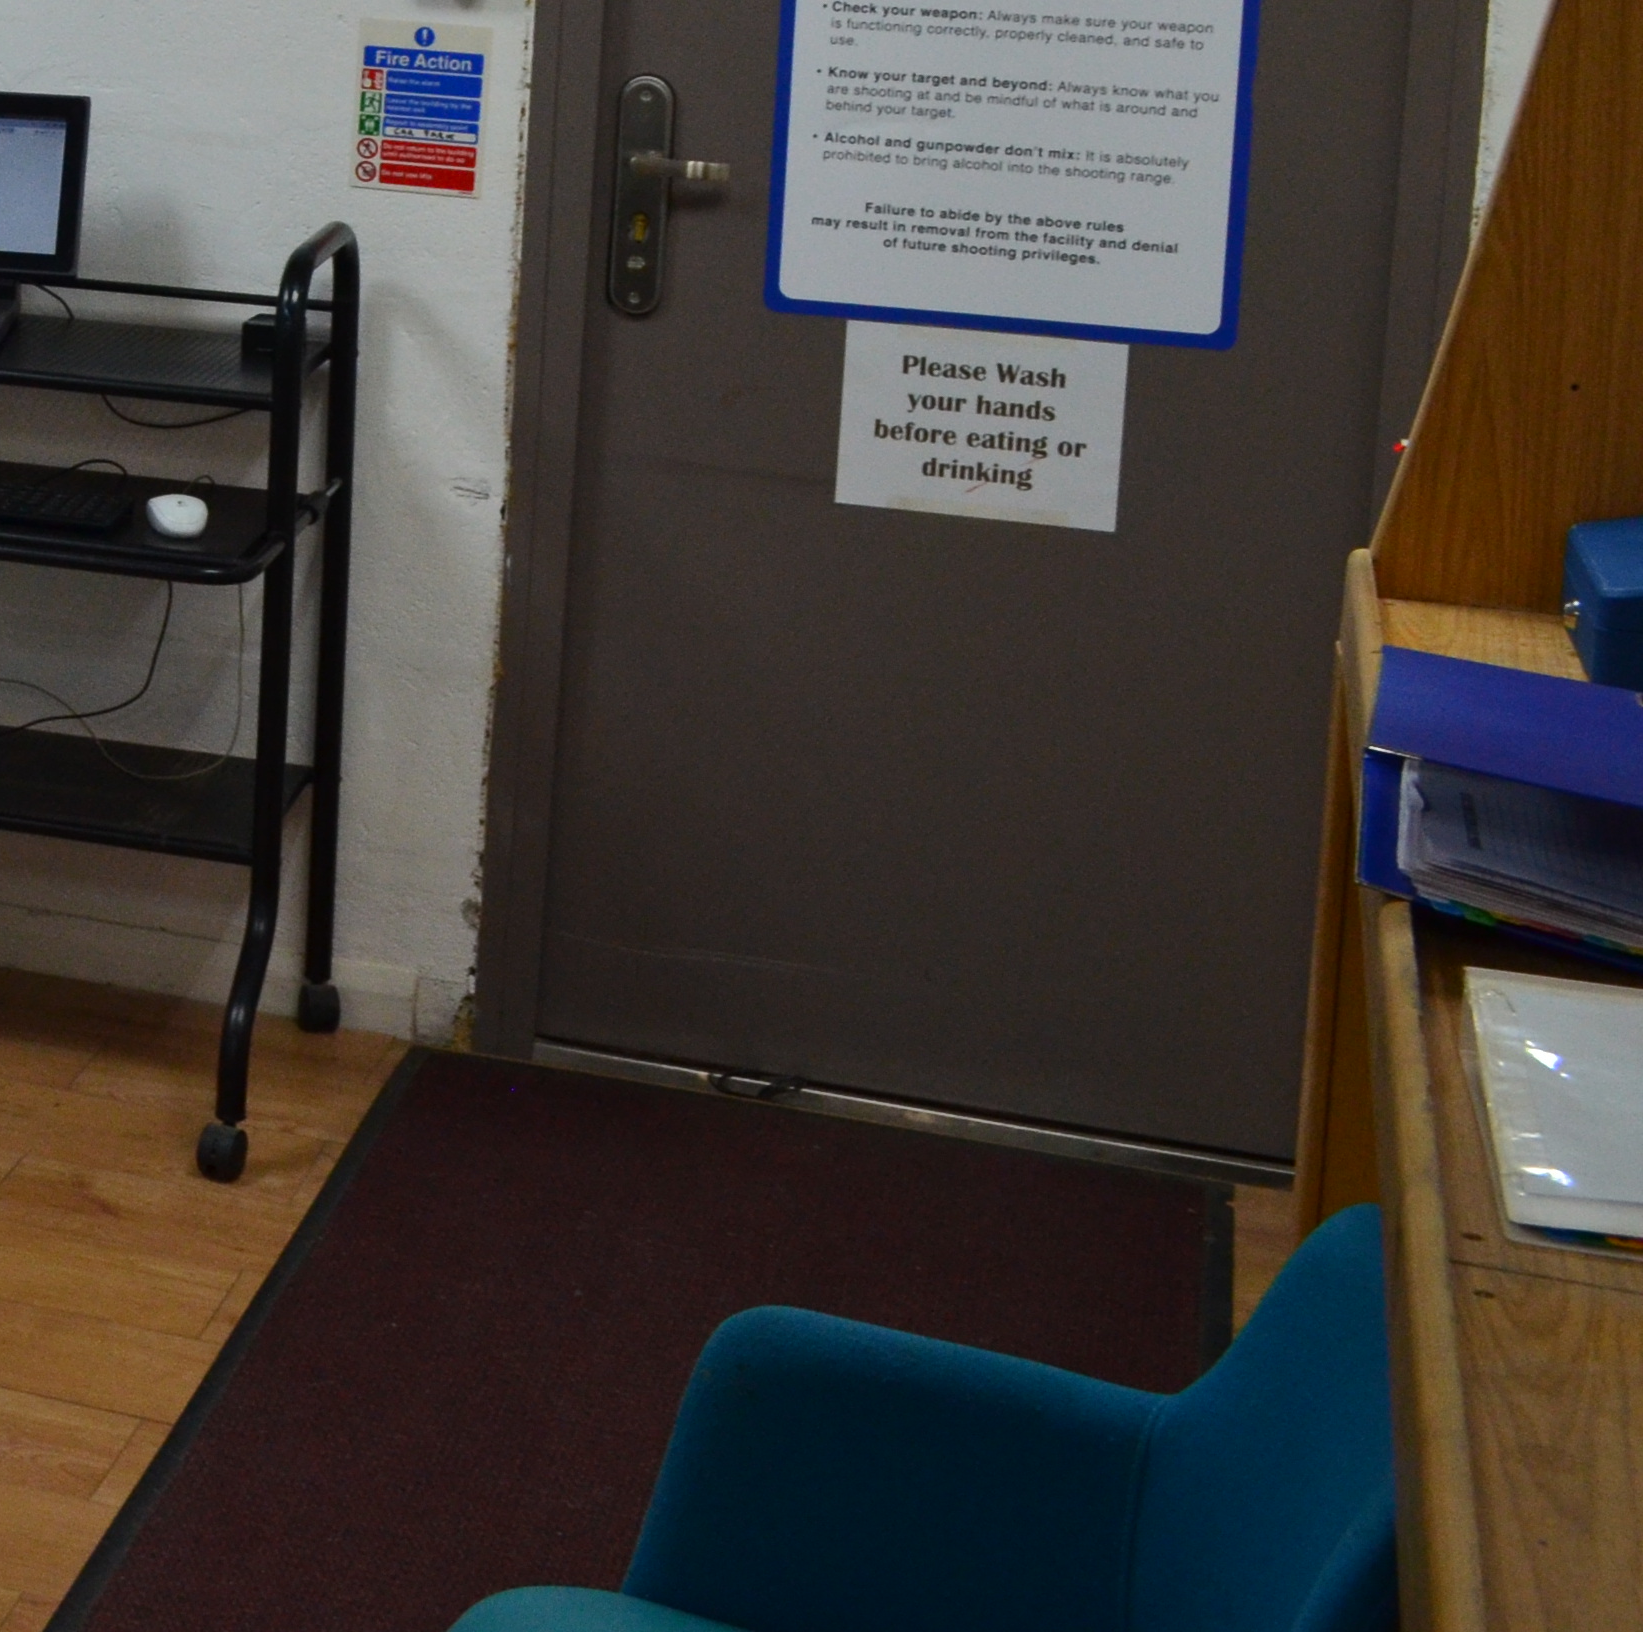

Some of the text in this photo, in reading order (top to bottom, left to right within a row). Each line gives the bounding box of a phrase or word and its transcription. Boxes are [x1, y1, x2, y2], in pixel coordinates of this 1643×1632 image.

[831, 0, 878, 13] Check
[881, 5, 916, 17] your
[986, 10, 1037, 24] Always
[1041, 13, 1080, 25] make
[1085, 17, 1116, 27] sure
[1121, 19, 1152, 31] your
[1156, 22, 1214, 35] weapon
[374, 50, 472, 72] Fire Action
[827, 66, 869, 78] Know
[873, 71, 907, 82] your
[910, 71, 955, 86] target
[959, 74, 987, 86] and
[1056, 81, 1107, 96] Always
[1112, 84, 1149, 96] know
[1154, 87, 1188, 99] what
[1192, 91, 1219, 103] you
[824, 131, 880, 145] Alcohol
[884, 136, 912, 147] and
[915, 138, 1000, 156] gunpowder
[1085, 150, 1095, 160] It
[1099, 151, 1111, 162] is
[1115, 152, 1189, 169] absolutely
[810, 216, 1179, 253] may result in removal from the facility and denial
[864, 202, 1125, 232] Failure to abide by the above rules
[882, 236, 898, 247] of
[902, 238, 947, 251] future
[950, 242, 1017, 259] shooting
[901, 354, 1067, 389] Please Wash
[906, 391, 1056, 423] your hands
[873, 419, 1088, 459] before eating or
[921, 457, 1034, 492] drinking
